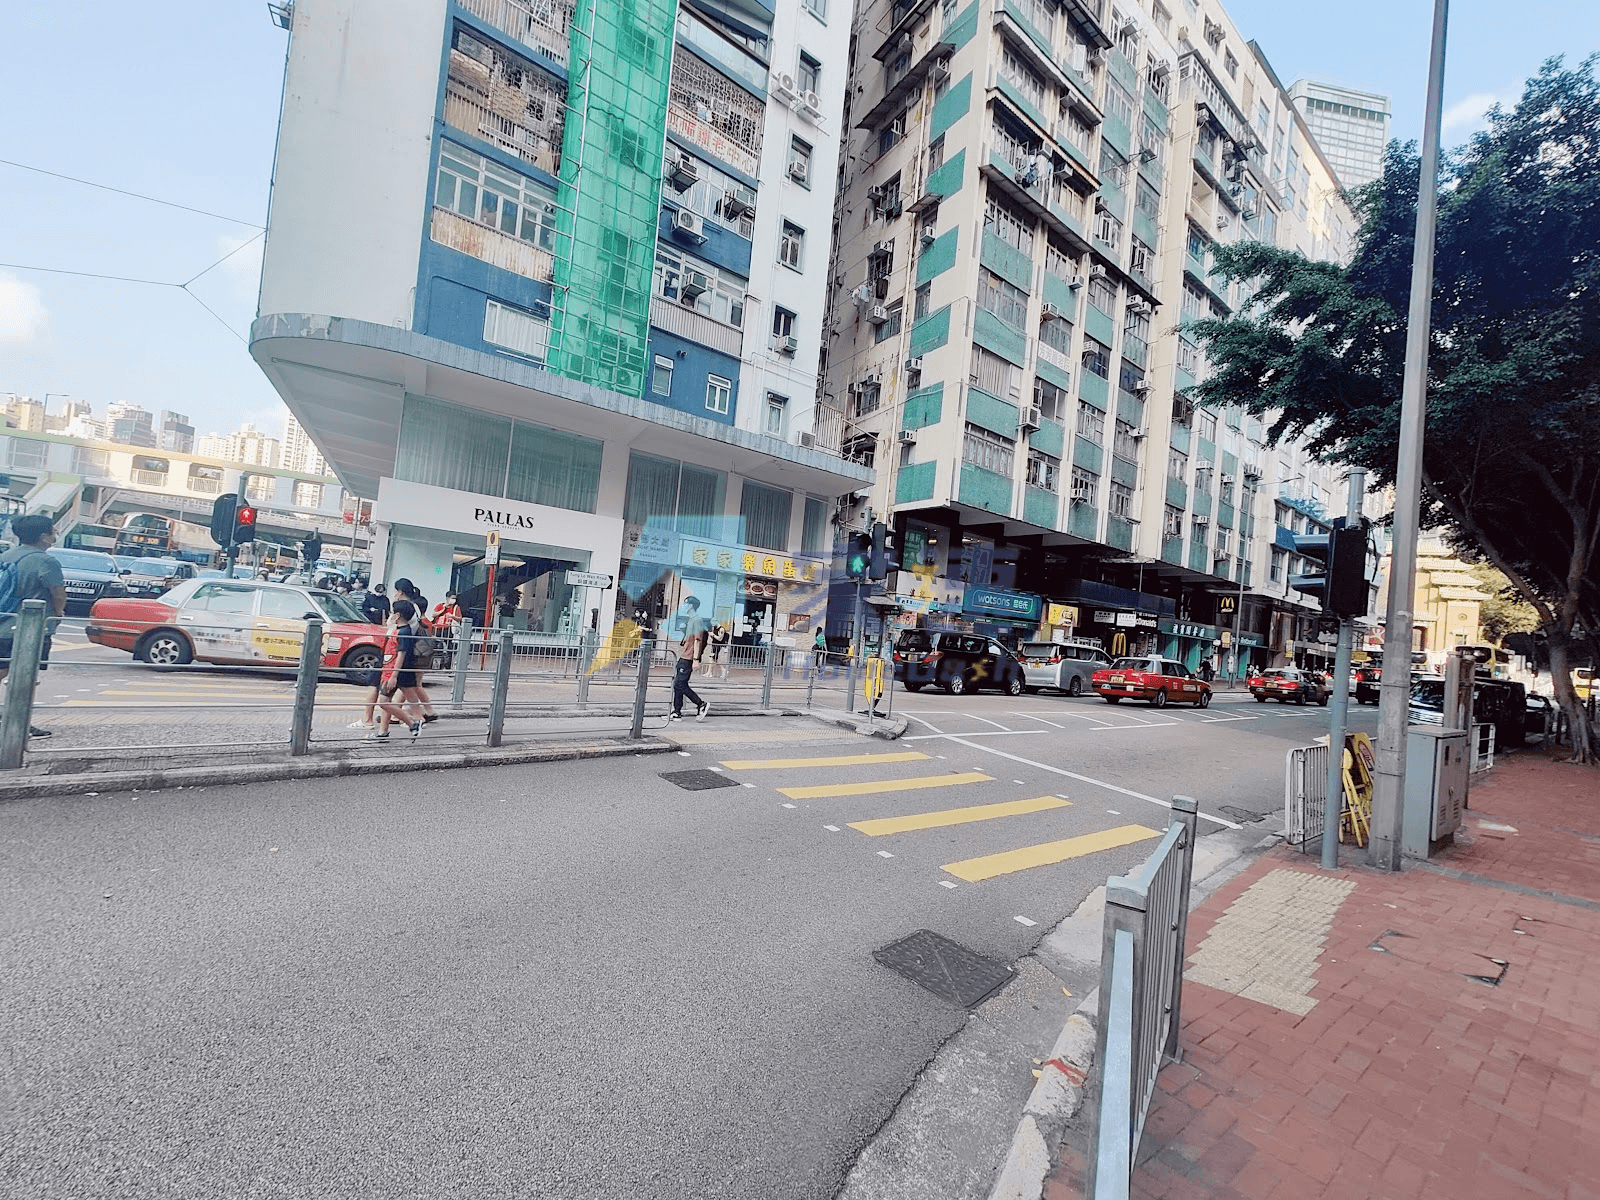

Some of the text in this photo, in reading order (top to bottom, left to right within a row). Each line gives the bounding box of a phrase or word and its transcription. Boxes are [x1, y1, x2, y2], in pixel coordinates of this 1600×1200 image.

[474, 507, 534, 529] PALLAS
[977, 593, 1011, 607] watsons
[1135, 617, 1158, 628] cDonald's
